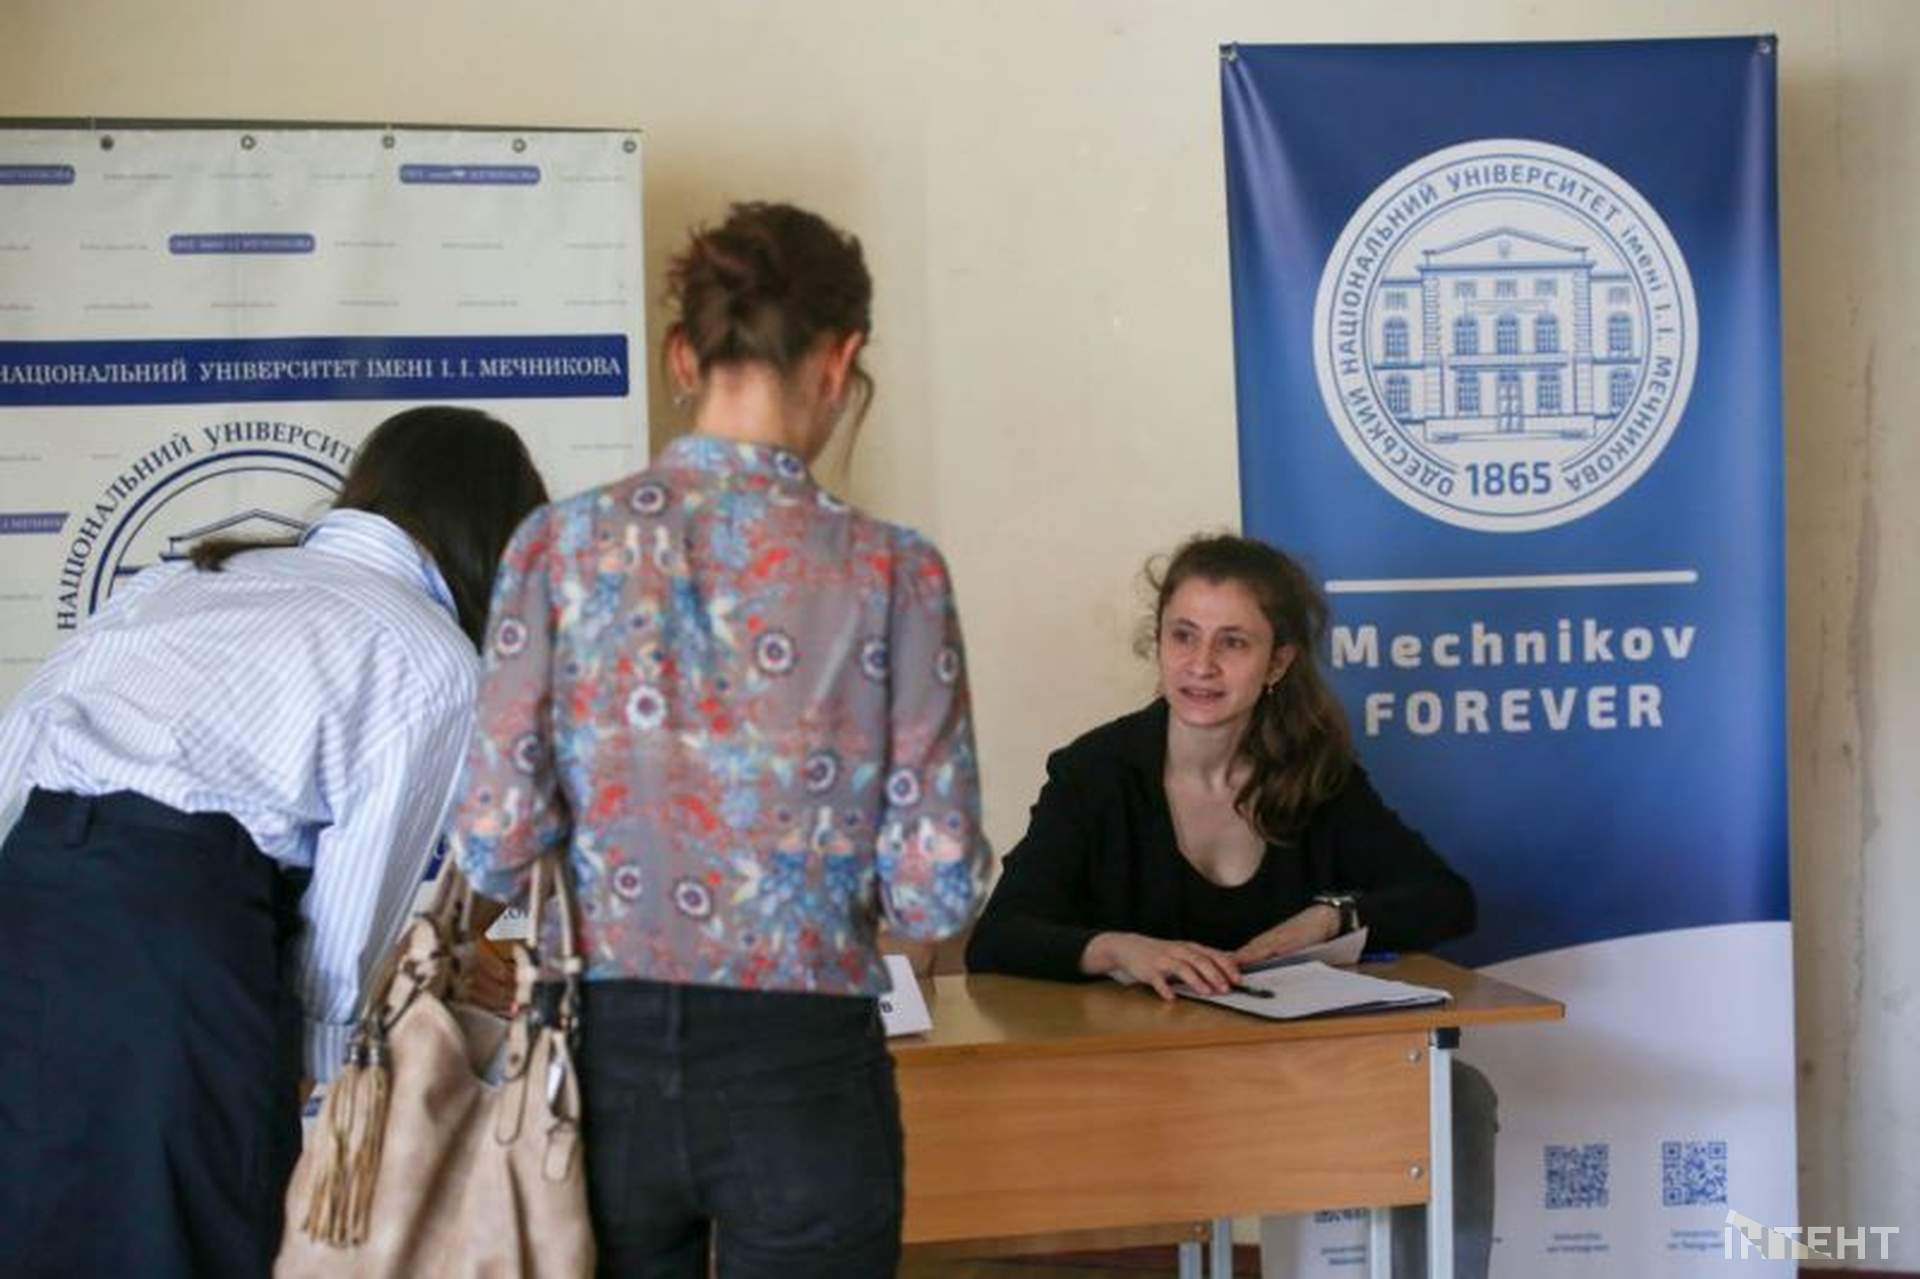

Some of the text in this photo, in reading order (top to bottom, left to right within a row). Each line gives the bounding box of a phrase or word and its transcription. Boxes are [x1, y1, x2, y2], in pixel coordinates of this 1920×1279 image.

[1446, 164, 1621, 222] УНІВЕРСИТЕТ
[1338, 182, 1439, 375] НАЦІОНАЛЬНИЙ
[199, 358, 357, 381] УНІВЕРСИТЕТ
[367, 359, 434, 378] ІМЕНІ
[479, 356, 621, 378] МЕЧНИКОВА
[1347, 386, 1454, 497] ОДЕСЬКИЙ
[1564, 355, 1672, 492] МЕЧНИКОВА
[1465, 461, 1552, 496] 1865
[57, 420, 356, 630] НАЦІОНАЛЬНИЙ УНІВЕРСИТ
[1330, 617, 1697, 668] Mechnikov
[1364, 684, 1663, 736] FOREVER
